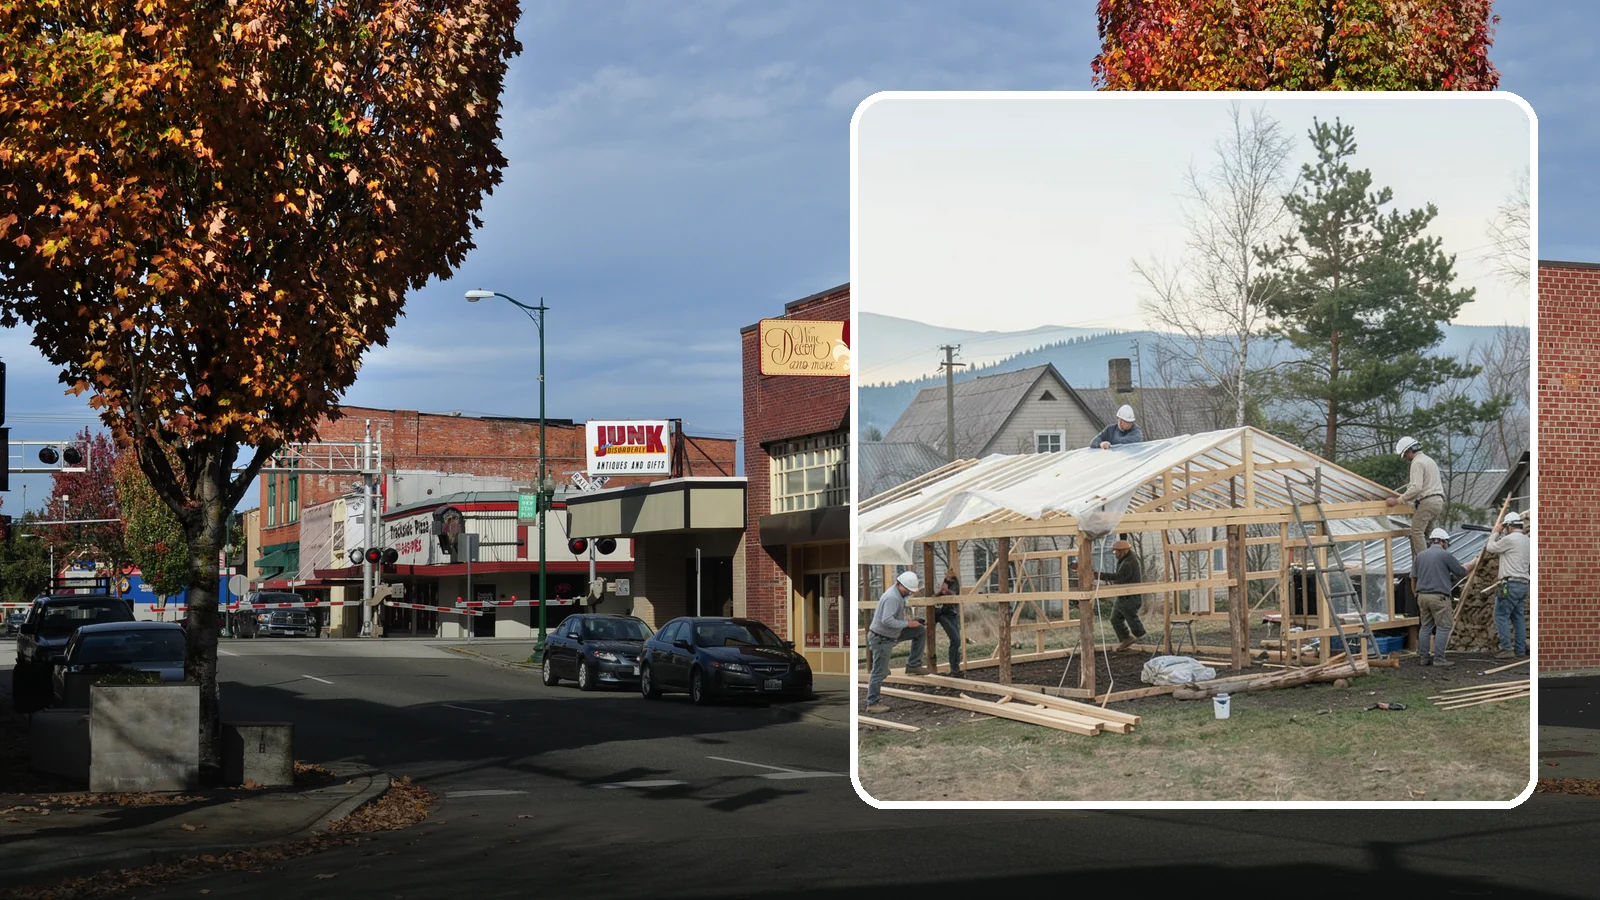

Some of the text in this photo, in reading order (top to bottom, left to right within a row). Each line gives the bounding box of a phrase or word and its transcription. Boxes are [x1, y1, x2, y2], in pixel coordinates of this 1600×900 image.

[595, 425, 665, 457] JUNK
[607, 446, 646, 454] DISORDERLY
[596, 460, 666, 470] ANTIQUES AND GIFTS
[414, 519, 429, 535] Pizza
